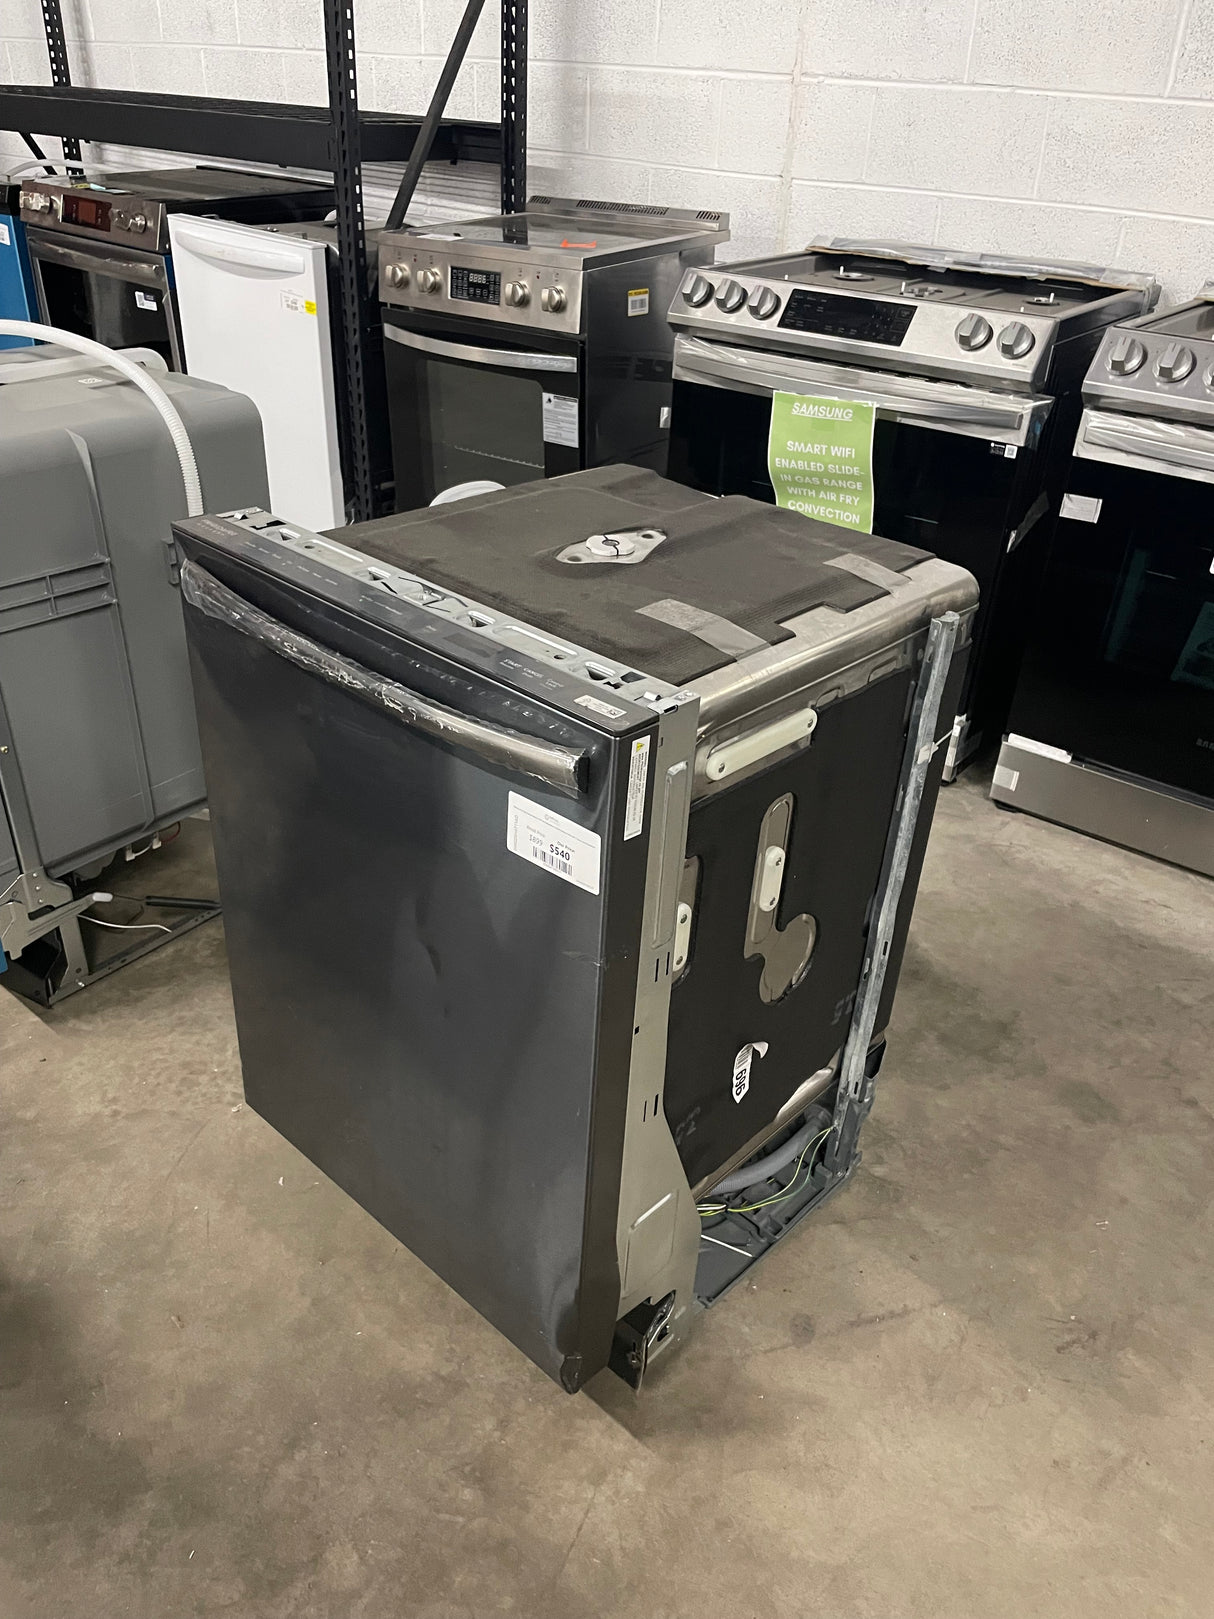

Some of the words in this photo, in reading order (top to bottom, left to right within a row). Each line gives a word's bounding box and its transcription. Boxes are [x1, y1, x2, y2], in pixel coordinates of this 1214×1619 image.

[792, 402, 853, 420] SAMSUNG
[786, 440, 828, 455] SMART
[830, 445, 855, 459] WIFI
[775, 457, 825, 472] ENABLED
[827, 463, 865, 476] SLIDE-
[780, 473, 792, 482] IN
[794, 475, 820, 485] GAS
[822, 477, 863, 490] RANGE
[786, 485, 816, 497] WITH
[818, 491, 837, 501] AIR
[839, 495, 860, 506] FRY
[788, 500, 860, 523] CONVECTION
[549, 843, 571, 861] $540
[735, 1068, 747, 1096] 696
